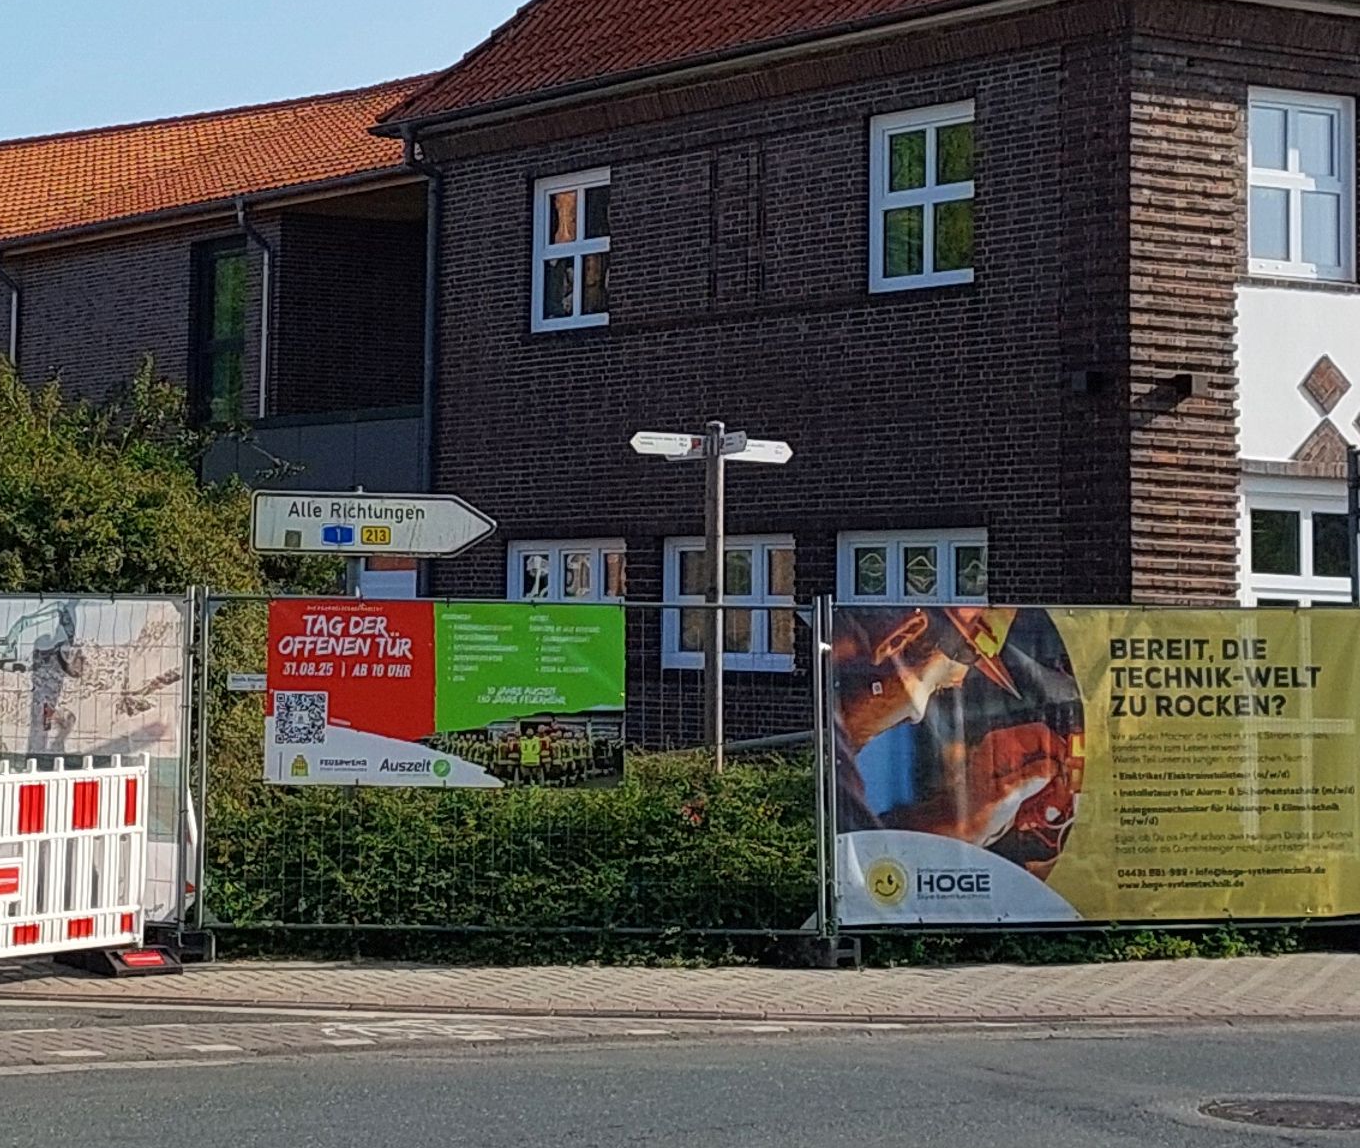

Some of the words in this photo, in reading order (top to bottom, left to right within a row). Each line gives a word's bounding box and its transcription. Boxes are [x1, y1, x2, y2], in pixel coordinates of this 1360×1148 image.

[288, 501, 322, 518] Alle
[330, 502, 426, 524] Richtungen
[365, 529, 387, 543] 213
[303, 614, 346, 637] TAG
[349, 616, 389, 638] DER
[278, 636, 371, 658] OFFENEN
[375, 631, 413, 660] TÜR
[1110, 638, 1215, 663] BEREIT,
[1222, 638, 1268, 660] DIE
[282, 662, 334, 677] 31.08.25
[351, 664, 368, 677] AB
[371, 664, 384, 677] 10
[388, 664, 412, 678] UHR
[1110, 665, 1322, 689] TECHNIK-WELT
[1110, 694, 1147, 717] ZU
[1155, 694, 1287, 717] ROCKEN?
[379, 758, 432, 773] Auszeit
[917, 874, 991, 893] HOGE
